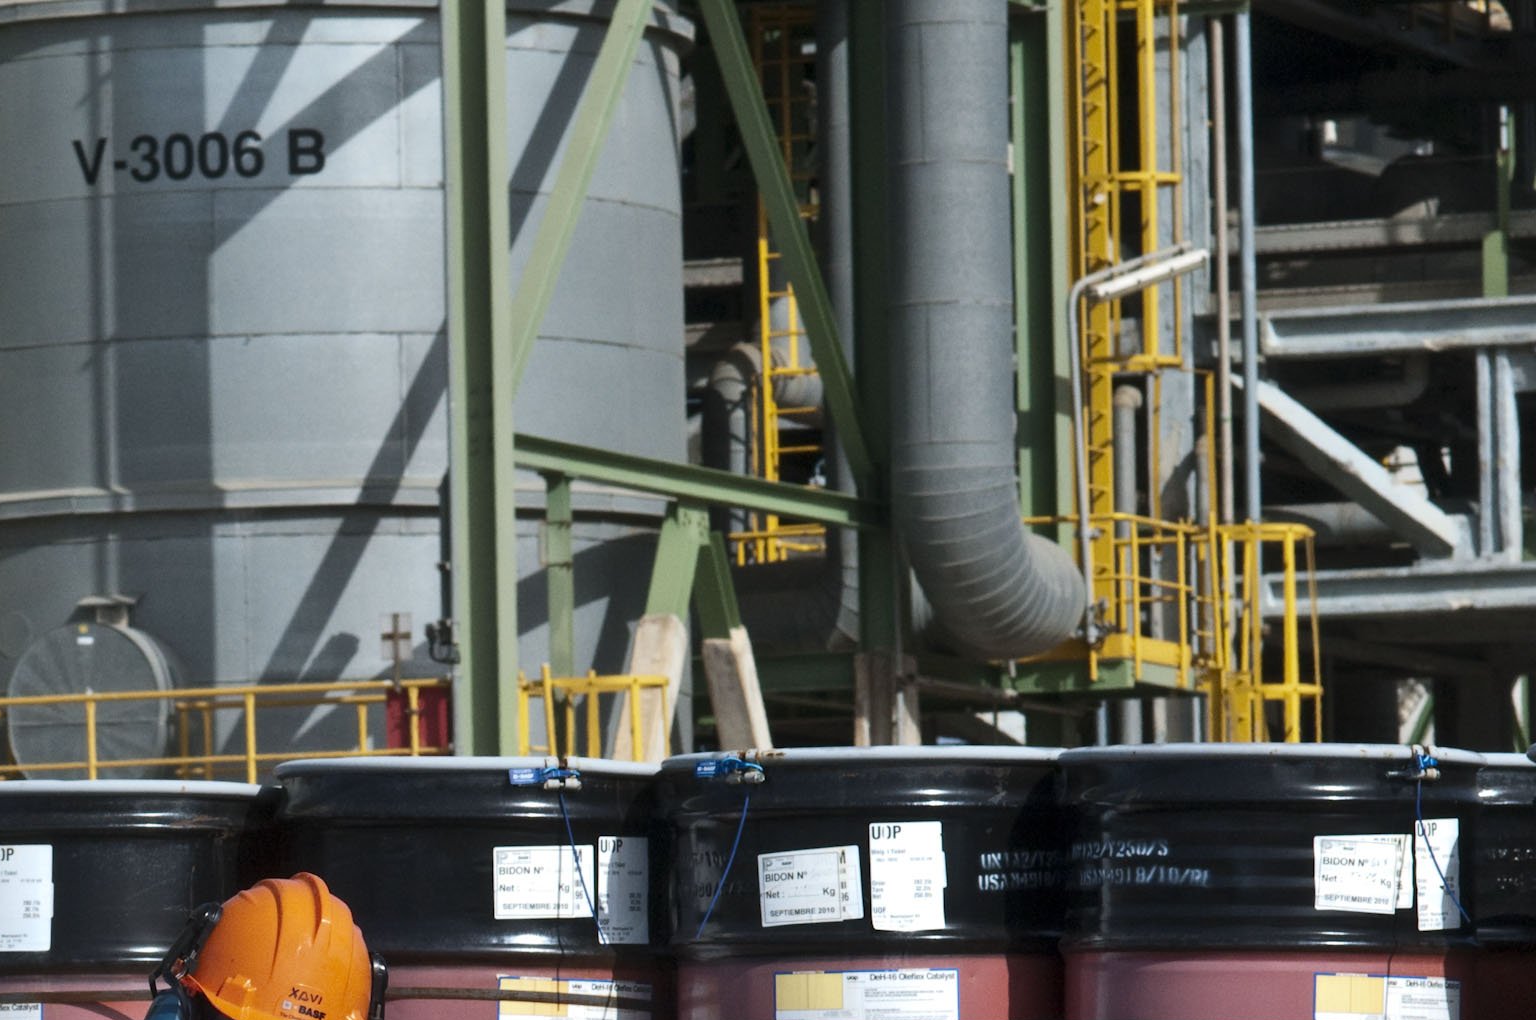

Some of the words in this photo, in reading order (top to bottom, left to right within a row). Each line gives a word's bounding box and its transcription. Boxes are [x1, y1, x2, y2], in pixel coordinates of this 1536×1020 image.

[73, 130, 263, 186] V-3006
[288, 128, 326, 176] B
[1322, 856, 1355, 867] BIDON
[498, 866, 531, 876] BIDON
[765, 871, 794, 883] BIDON
[1322, 874, 1337, 882] Net
[1380, 879, 1392, 889] Kg
[499, 884, 515, 892] Net
[558, 884, 570, 894] Kg
[765, 890, 780, 899] Net
[822, 887, 836, 897] Kg
[1324, 893, 1372, 904] SEPTIEMBRE
[503, 903, 551, 911] SEPTIEMBRE
[770, 906, 816, 918] SEPTIEMBRE
[817, 906, 836, 915] 2010
[926, 972, 955, 981] Catalyst
[289, 986, 323, 1005] XAVI
[298, 1004, 326, 1020] BASF
